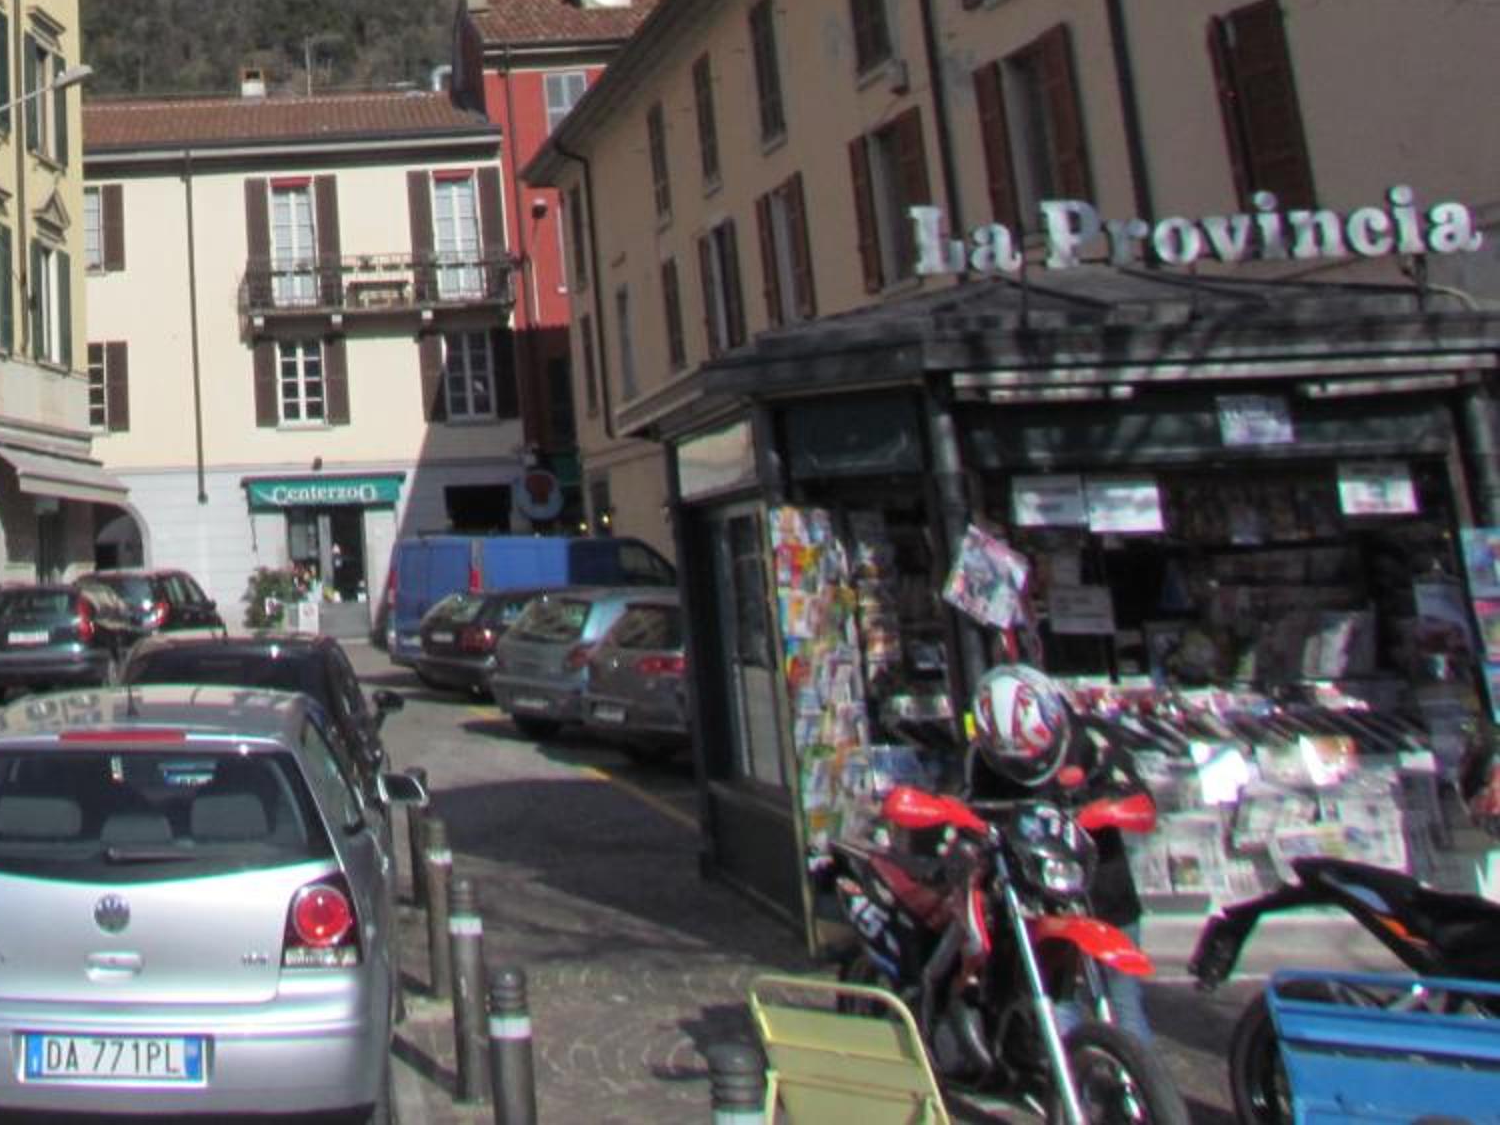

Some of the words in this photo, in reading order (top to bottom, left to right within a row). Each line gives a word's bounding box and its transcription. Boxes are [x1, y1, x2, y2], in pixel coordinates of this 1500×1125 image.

[908, 205, 1023, 274] La
[1039, 184, 1483, 269] Provincia
[46, 1038, 81, 1072] DA
[91, 1038, 181, 1073] 771PL
